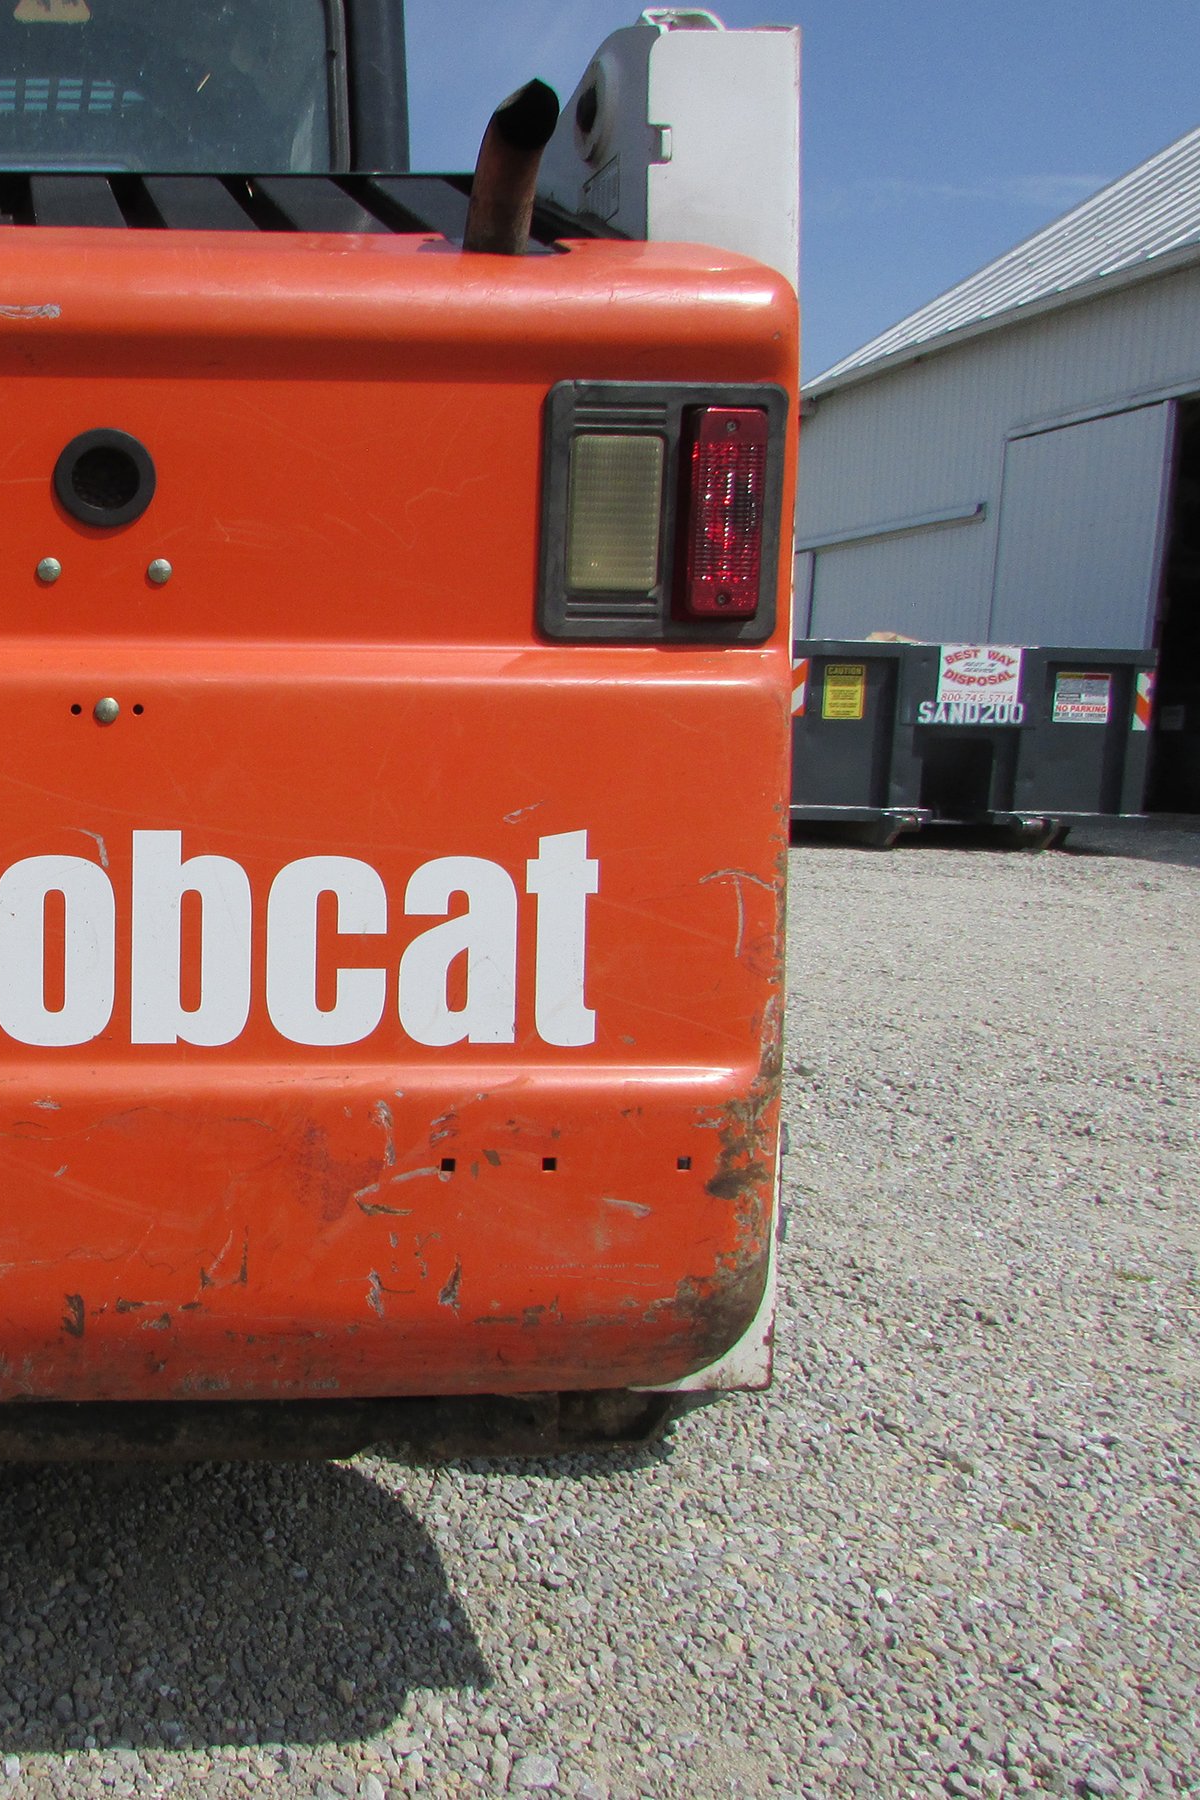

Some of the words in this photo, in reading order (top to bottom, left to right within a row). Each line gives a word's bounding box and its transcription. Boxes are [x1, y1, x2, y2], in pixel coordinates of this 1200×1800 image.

[944, 649, 980, 665] BEST
[988, 650, 1015, 667] WAY
[943, 669, 1016, 686] DISPOSAL
[941, 692, 1014, 703] 800-745-5714
[1056, 704, 1068, 712] NO
[1070, 704, 1107, 713] PARKING
